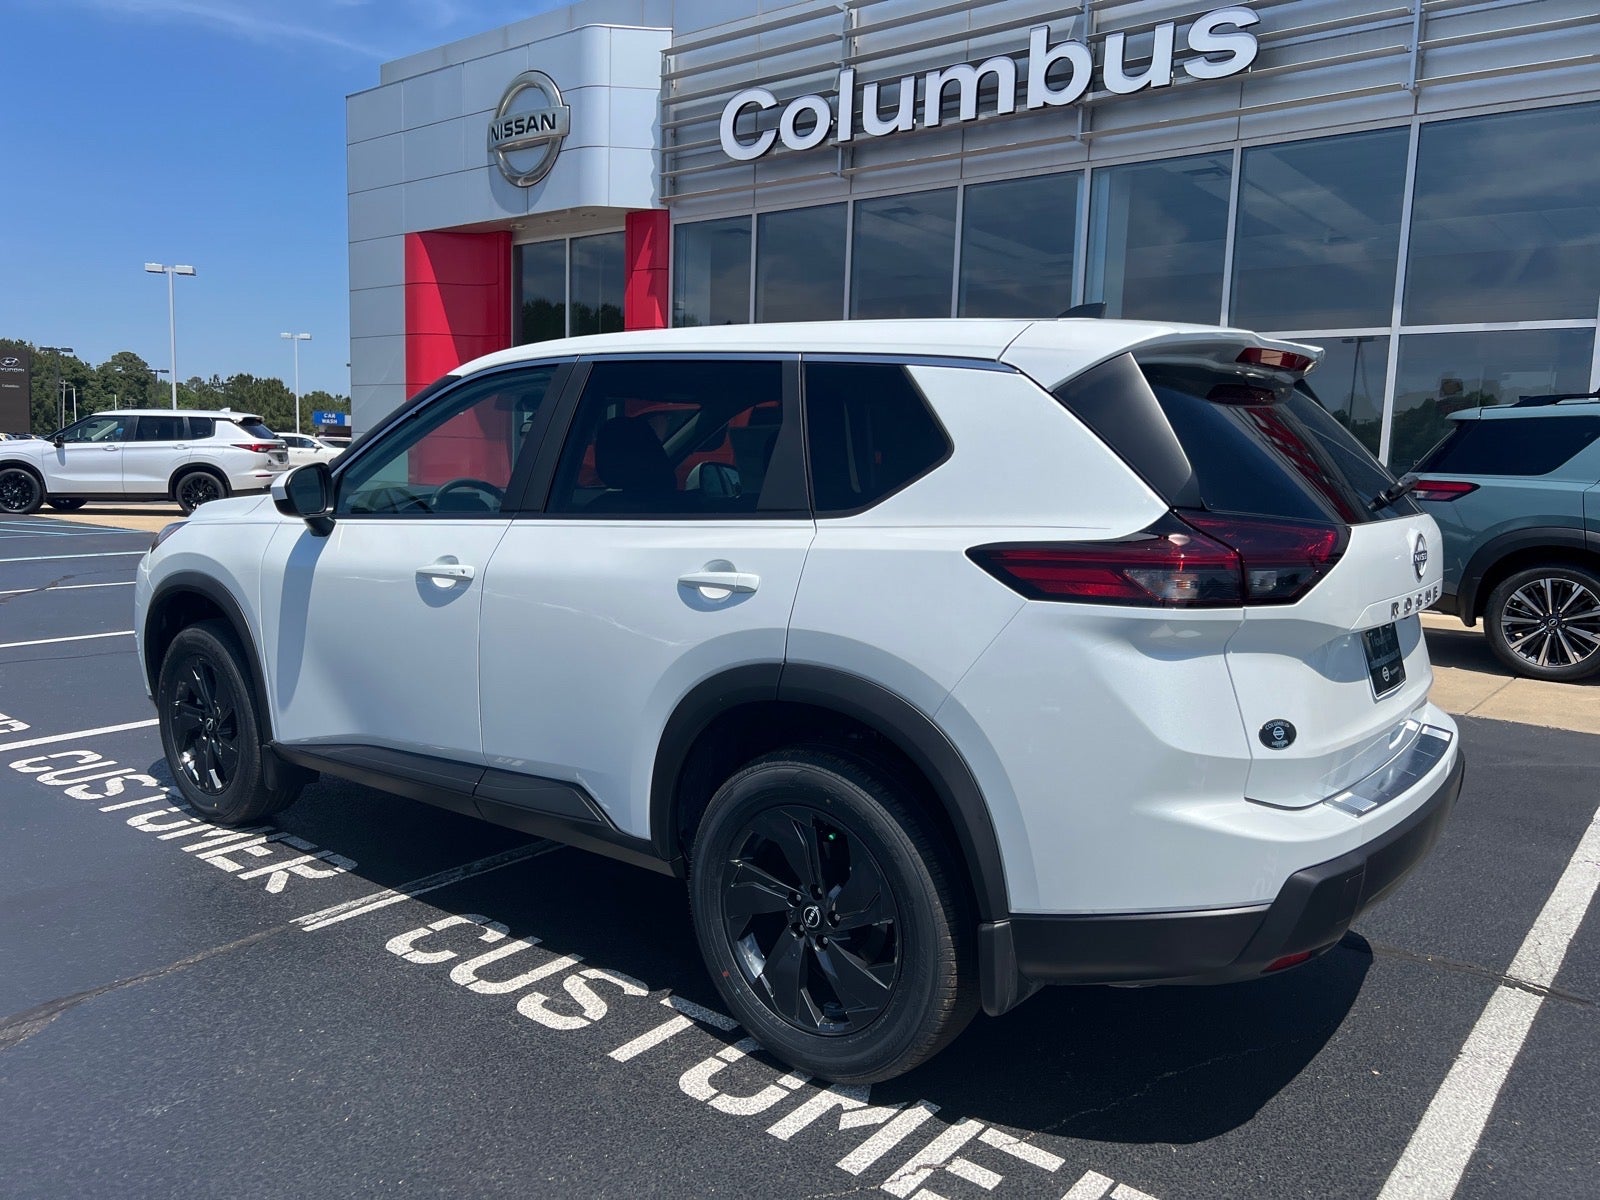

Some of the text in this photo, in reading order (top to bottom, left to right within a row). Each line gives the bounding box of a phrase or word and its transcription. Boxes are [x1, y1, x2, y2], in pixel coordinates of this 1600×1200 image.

[491, 113, 556, 142] NISSAN
[719, 5, 1261, 161] Columbus
[1391, 586, 1438, 619] ROGUE
[8, 749, 358, 894] CUSTOMER
